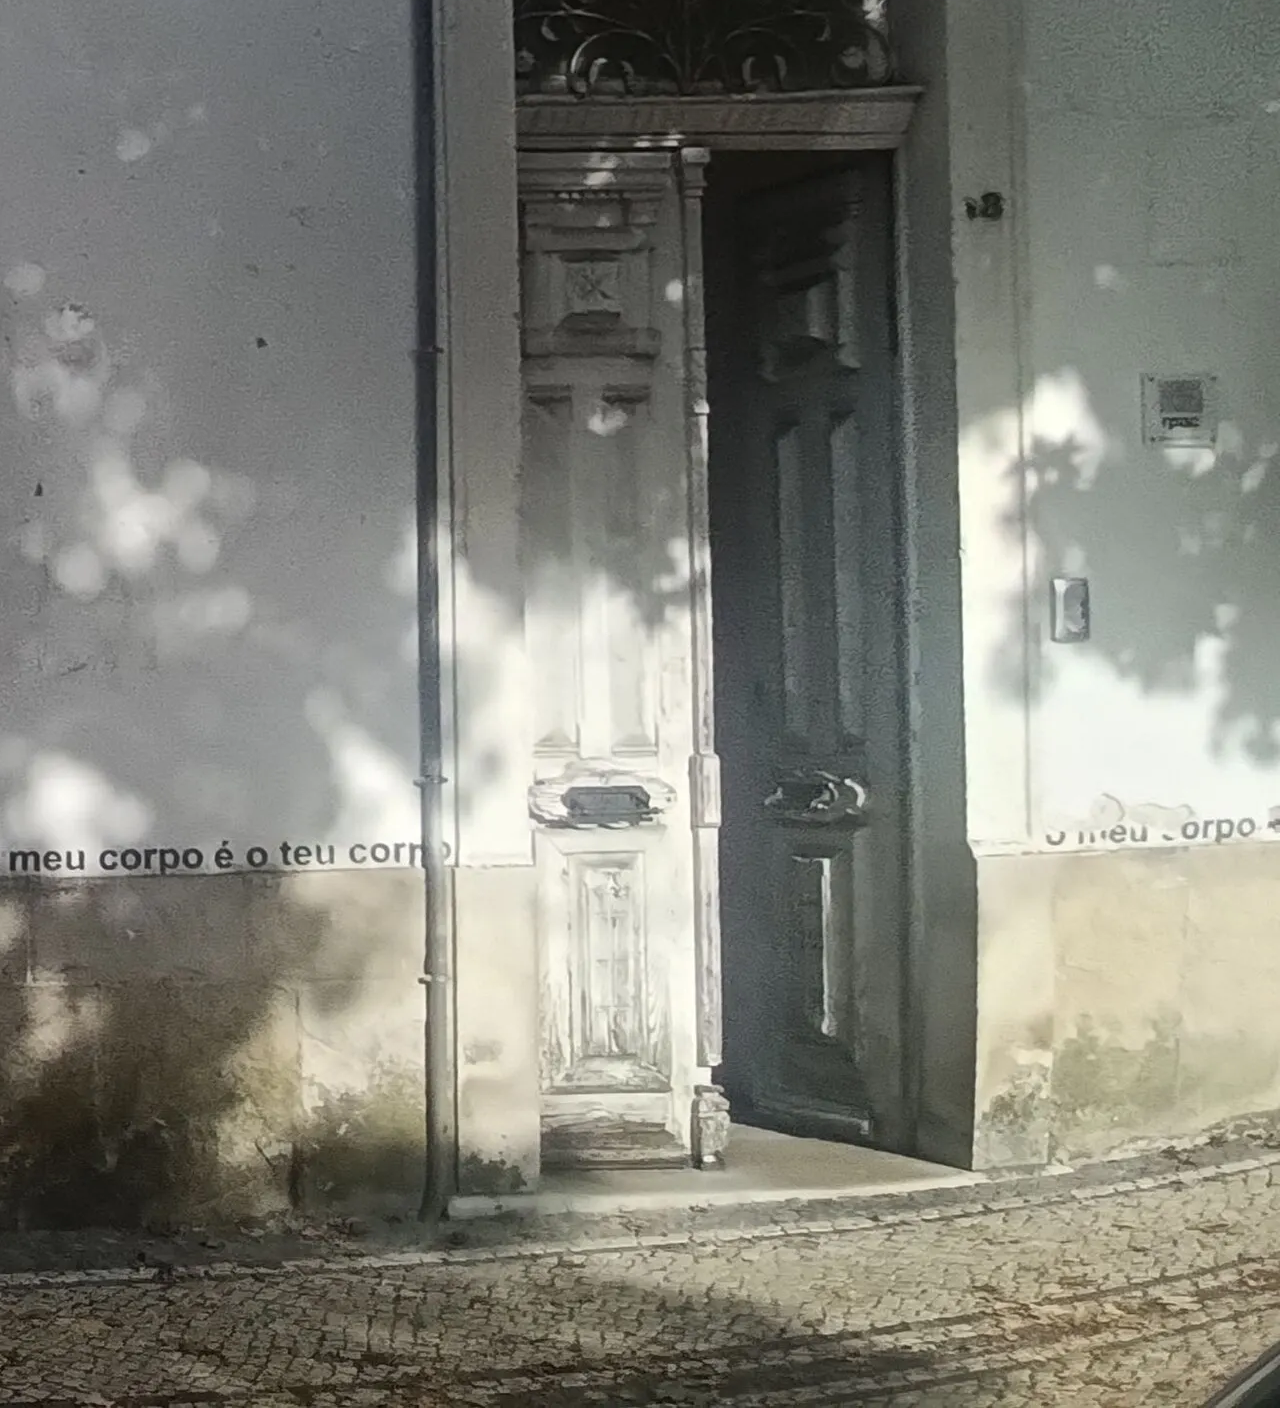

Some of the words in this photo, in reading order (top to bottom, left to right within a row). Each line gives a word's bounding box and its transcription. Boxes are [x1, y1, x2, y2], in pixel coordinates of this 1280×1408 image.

[1161, 817, 1257, 845] orpo
[8, 847, 85, 872] meu
[98, 846, 204, 876] corpo
[214, 840, 234, 869] é
[246, 846, 268, 868] o
[279, 841, 336, 867] teu
